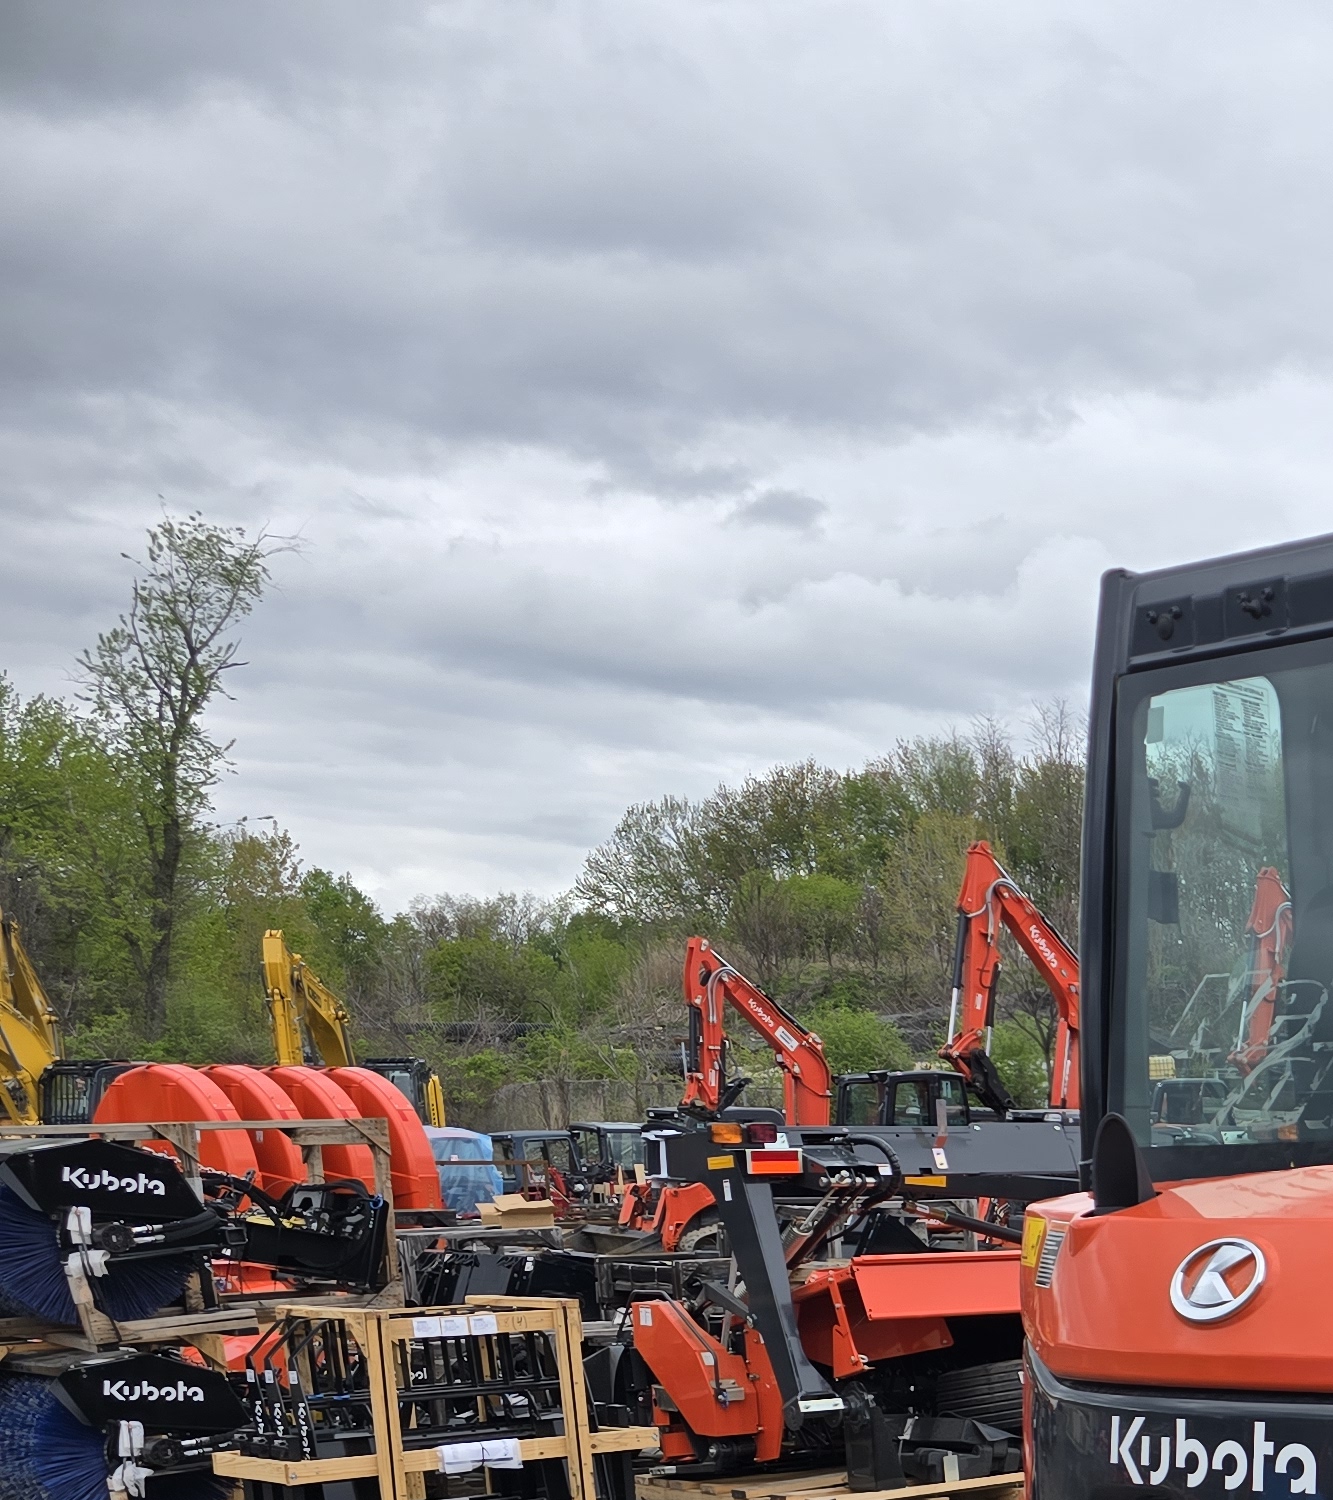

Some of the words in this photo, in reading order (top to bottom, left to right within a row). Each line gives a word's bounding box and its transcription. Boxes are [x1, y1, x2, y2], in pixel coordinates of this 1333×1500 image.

[1029, 924, 1058, 968] Kubota
[748, 998, 774, 1027] Kubota
[62, 1166, 166, 1196] Kubota
[103, 1379, 205, 1402] Kubota
[1110, 1415, 1317, 1495] Kubota
